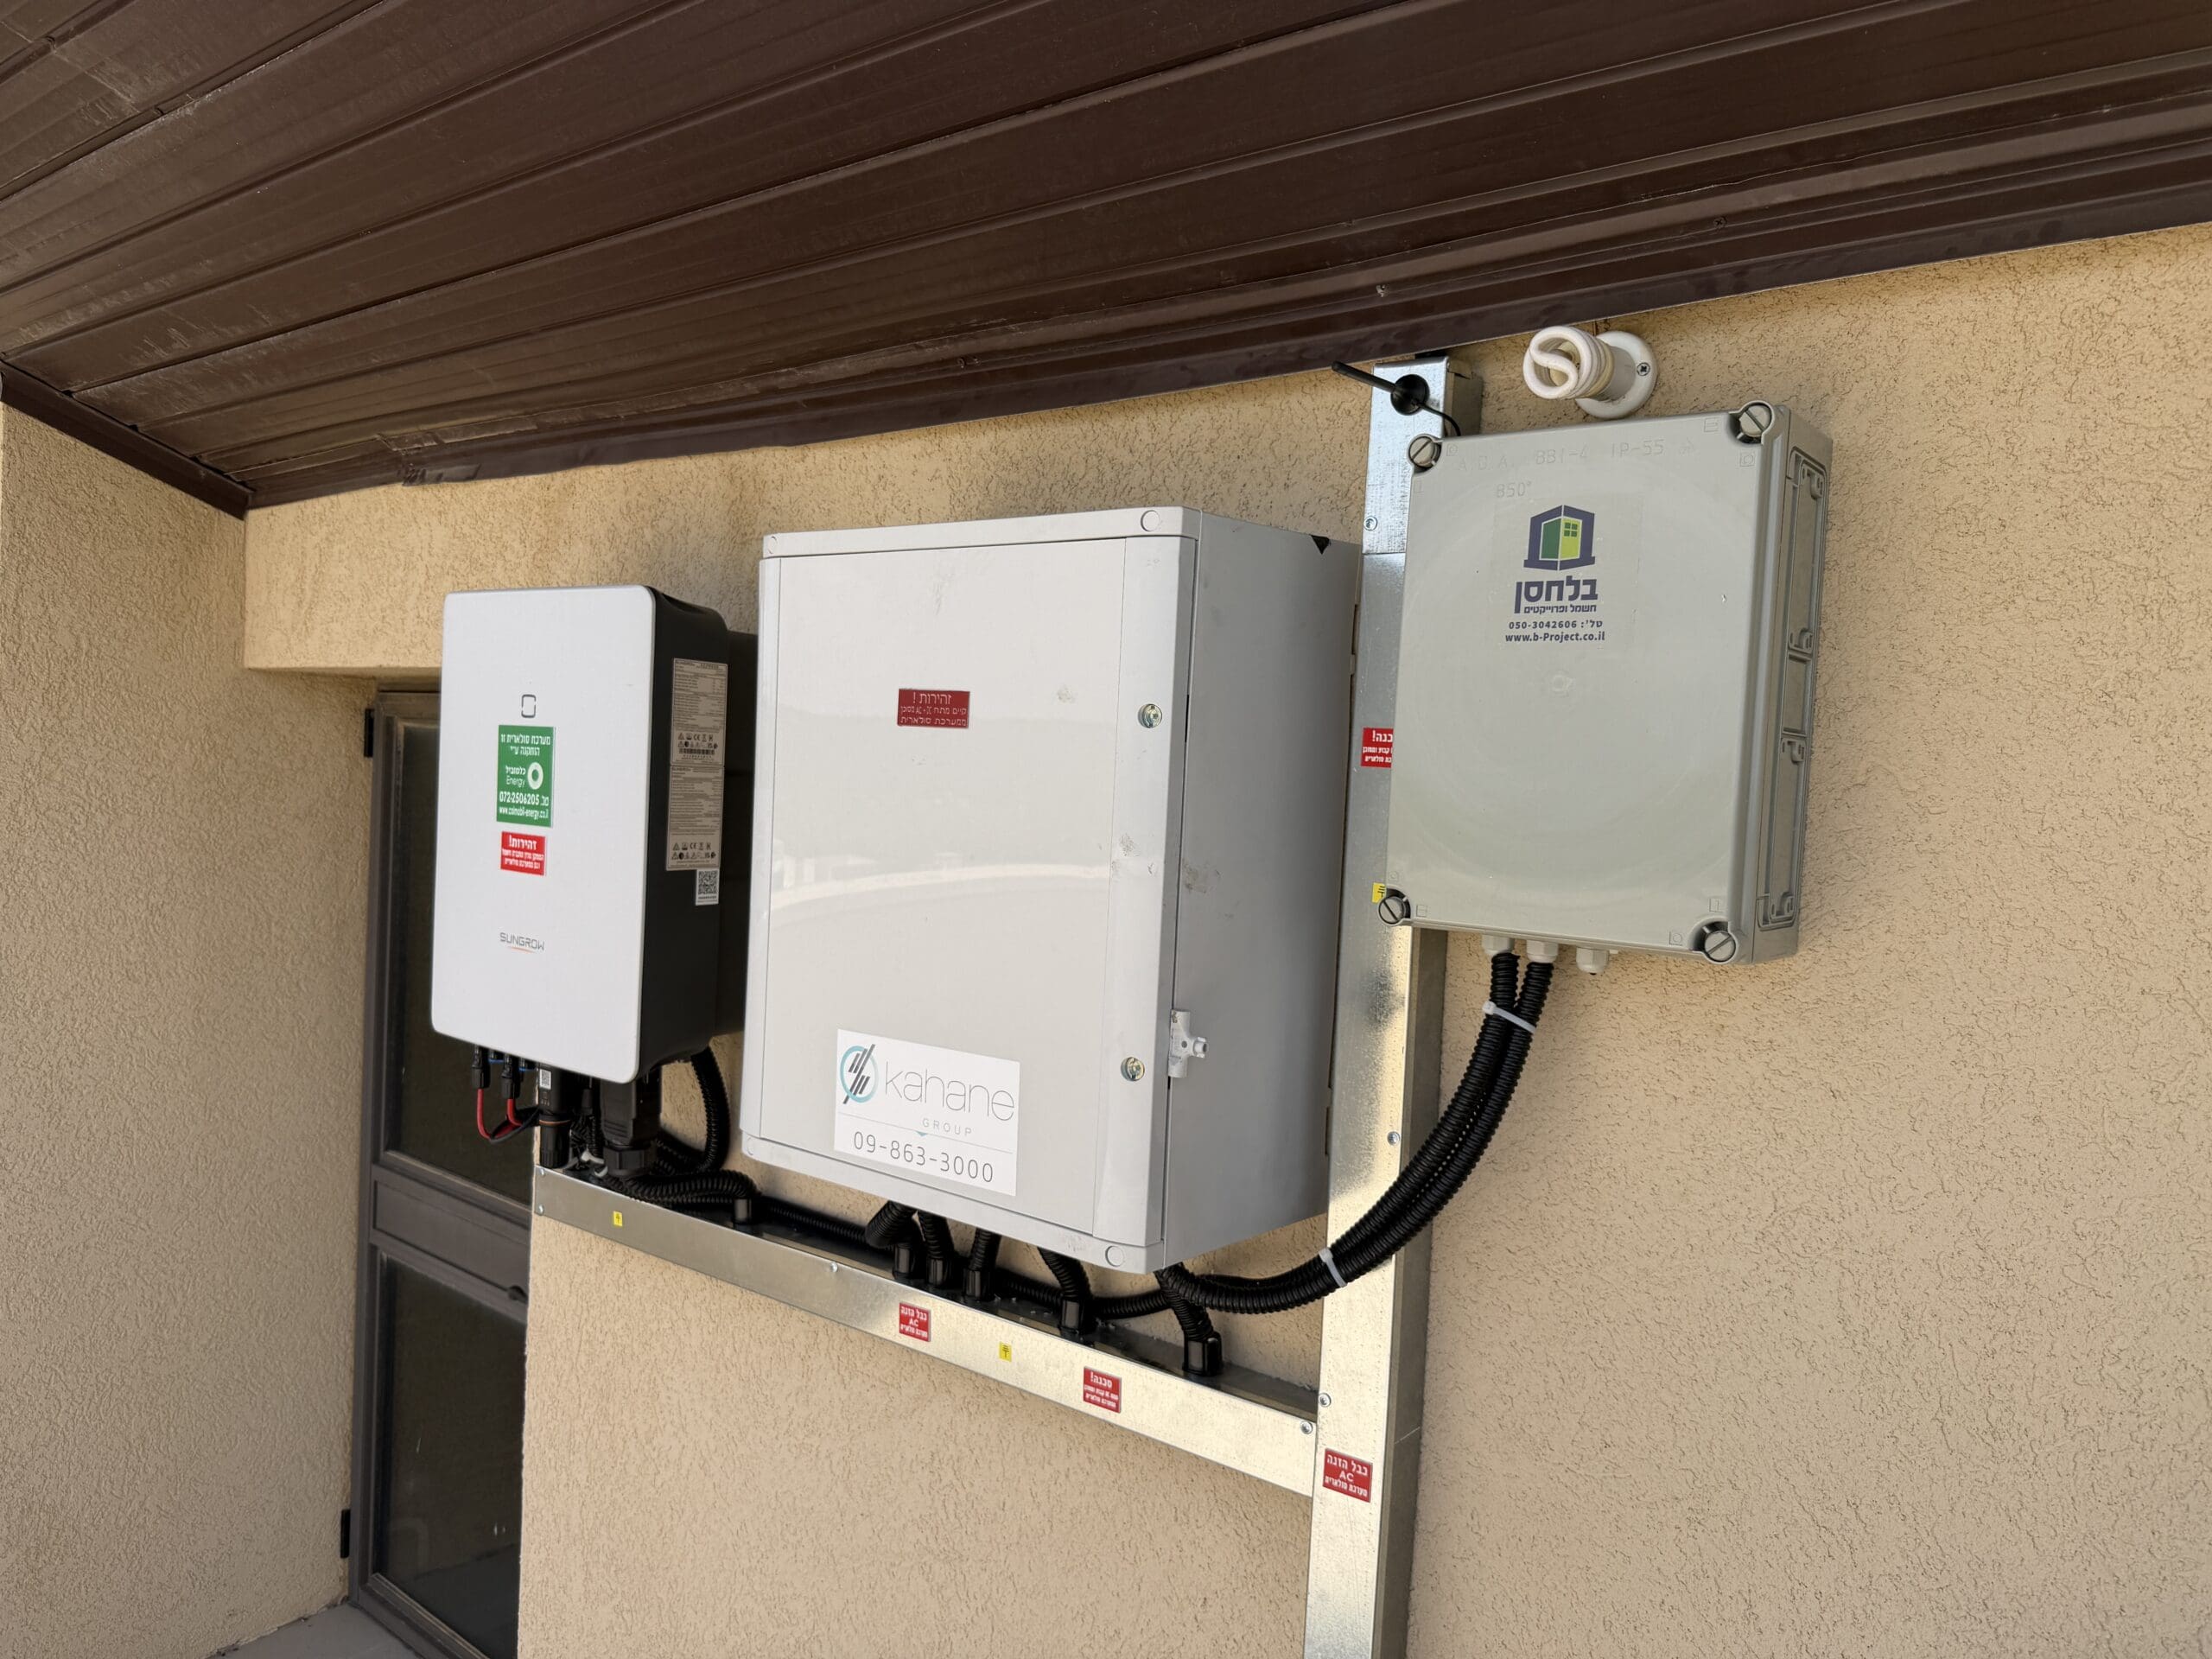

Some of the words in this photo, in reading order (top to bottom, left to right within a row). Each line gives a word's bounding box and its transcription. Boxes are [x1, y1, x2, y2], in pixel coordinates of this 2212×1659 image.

[1610, 438, 1664, 458] IP-55
[1514, 575, 1599, 614] בלחסן
[1570, 604, 1597, 613] חשמל
[1509, 620, 1577, 629] 050-3042606
[1505, 631, 1605, 643] www.b-Project.co.il
[918, 693, 952, 705] זהירות
[933, 707, 950, 715] מתח
[952, 707, 967, 715] קיים
[900, 716, 931, 725] סולארית
[506, 734, 530, 745] סולארית
[531, 734, 551, 746] מערכת
[1372, 729, 1393, 742] כנה!
[506, 775, 525, 788] Energy
[499, 791, 540, 805] 072-2506205
[508, 834, 537, 851] זהירות!
[499, 931, 545, 951] SUNGROW
[885, 1061, 1015, 1122] kahane
[922, 1117, 972, 1136] GROUP
[854, 1131, 994, 1183] 09-863-3000
[916, 1308, 927, 1321] כבל
[909, 1317, 919, 1327] AC
[1090, 1370, 1113, 1389] סכנה!
[1326, 1453, 1348, 1470] הזנה
[1351, 1459, 1368, 1476] כבל
[1339, 1470, 1354, 1483] AC
